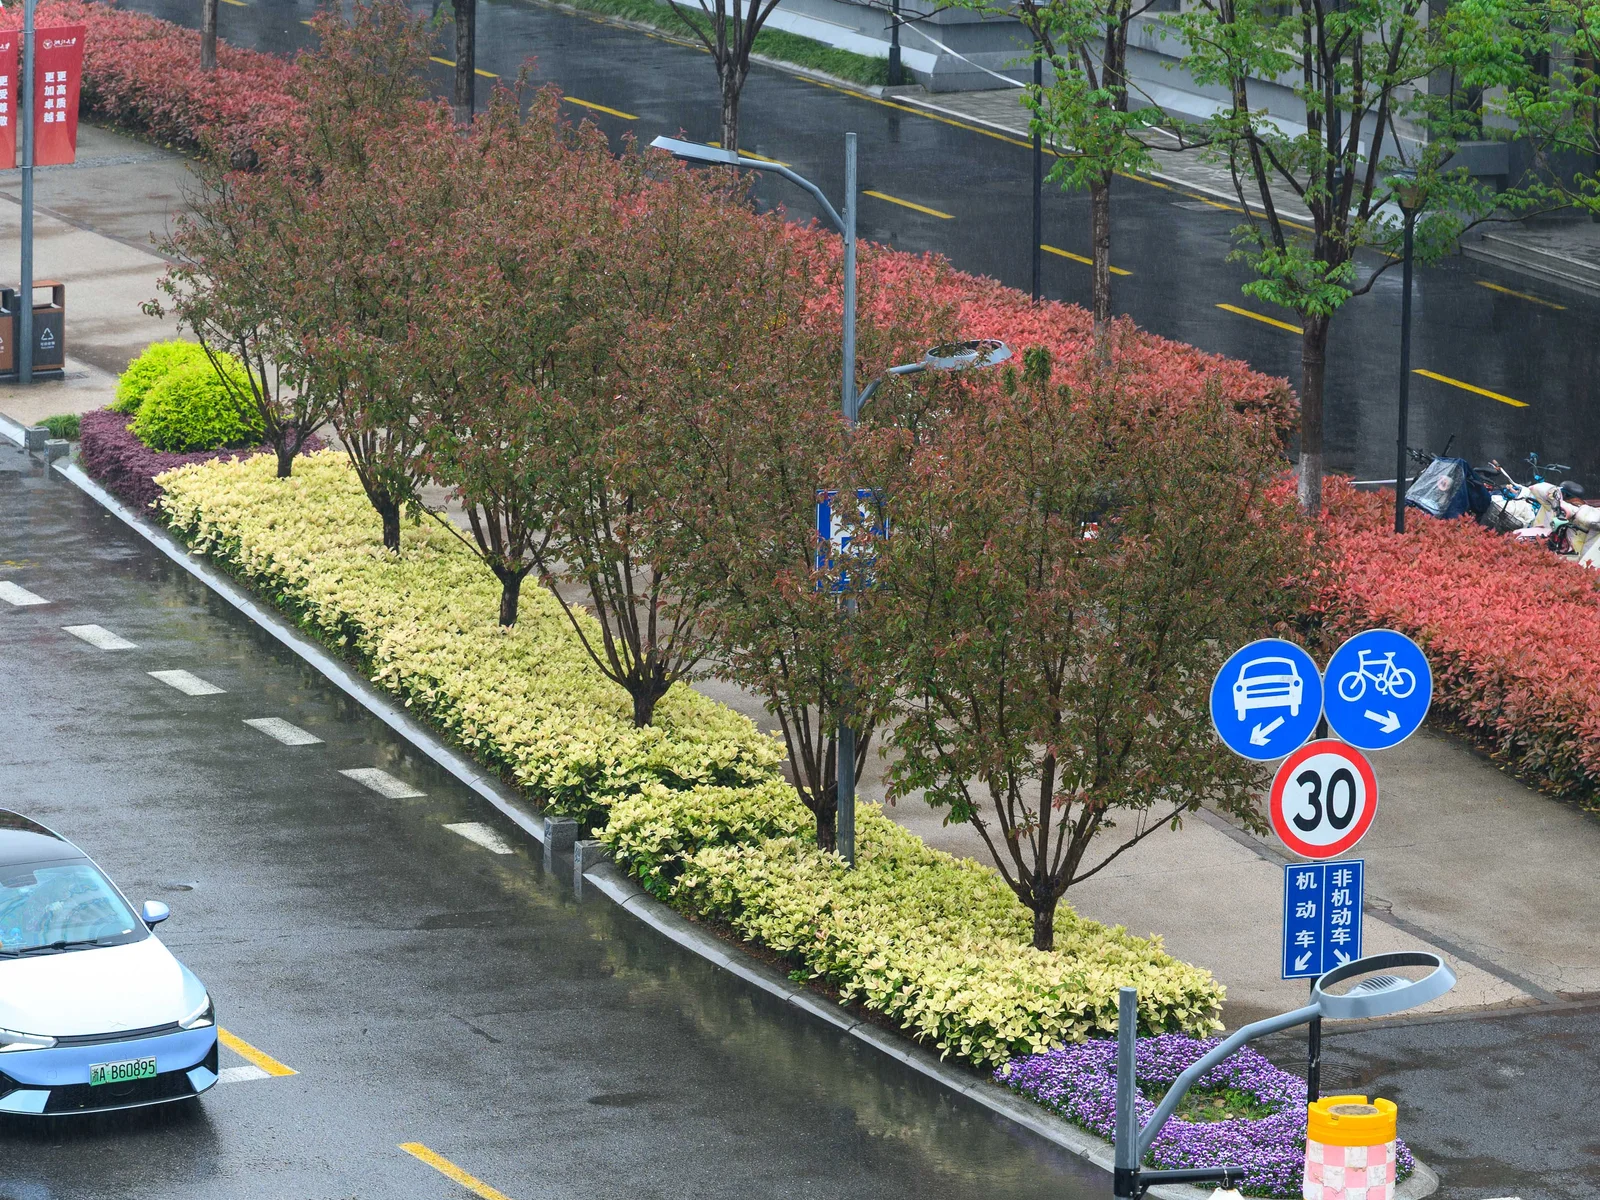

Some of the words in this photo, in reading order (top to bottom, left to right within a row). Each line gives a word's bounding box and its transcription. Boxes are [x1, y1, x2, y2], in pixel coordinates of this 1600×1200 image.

[43, 72, 54, 123] 更加卓越
[56, 71, 66, 122] 更高质量
[1293, 767, 1357, 832] 30
[1294, 871, 1317, 948] 机动车
[1330, 869, 1353, 946] 非机动车
